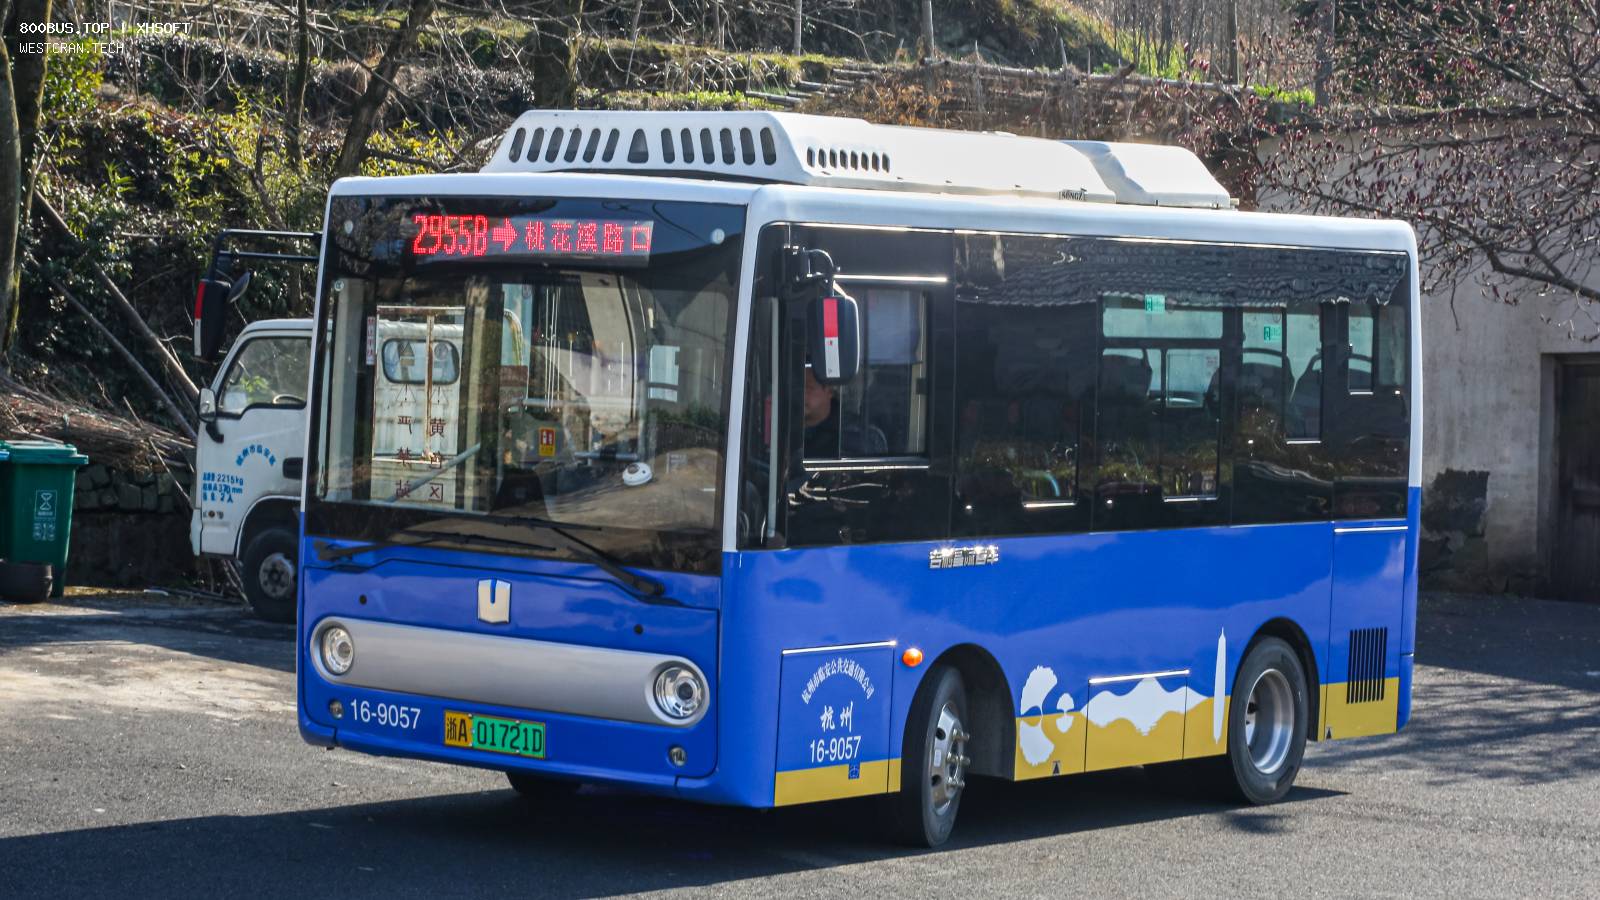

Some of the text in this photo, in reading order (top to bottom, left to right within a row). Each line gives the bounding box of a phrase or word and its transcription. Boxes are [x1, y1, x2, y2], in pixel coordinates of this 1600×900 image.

[413, 215, 650, 256] 2955B 桃花溪路口
[350, 698, 421, 729] 16-9057
[820, 700, 853, 733] 杭州
[810, 735, 862, 764] 16-9057
